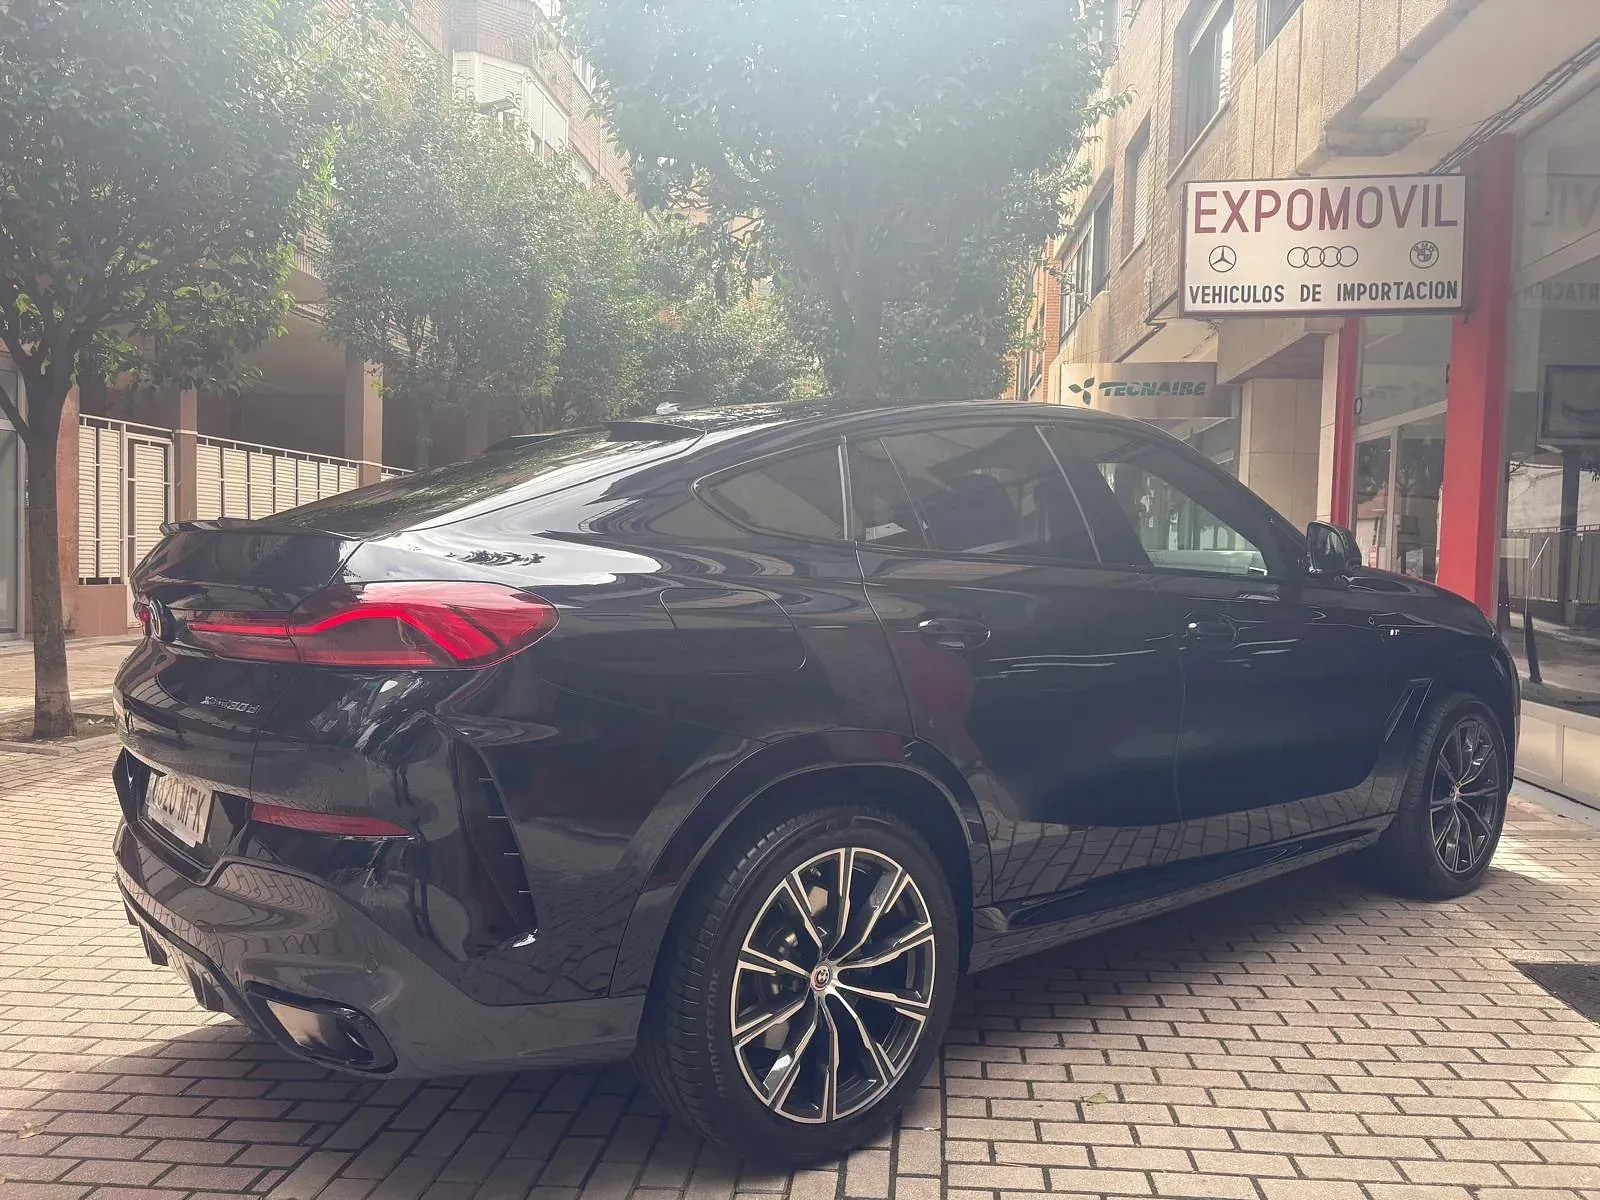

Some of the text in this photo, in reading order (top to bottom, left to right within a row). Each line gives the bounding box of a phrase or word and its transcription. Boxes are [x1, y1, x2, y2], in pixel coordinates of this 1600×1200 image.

[1193, 183, 1458, 234] EXPOMOVIL
[1188, 280, 1458, 304] VEHICULOS DE IMPORTACION
[1099, 381, 1206, 397] TECNAIRE
